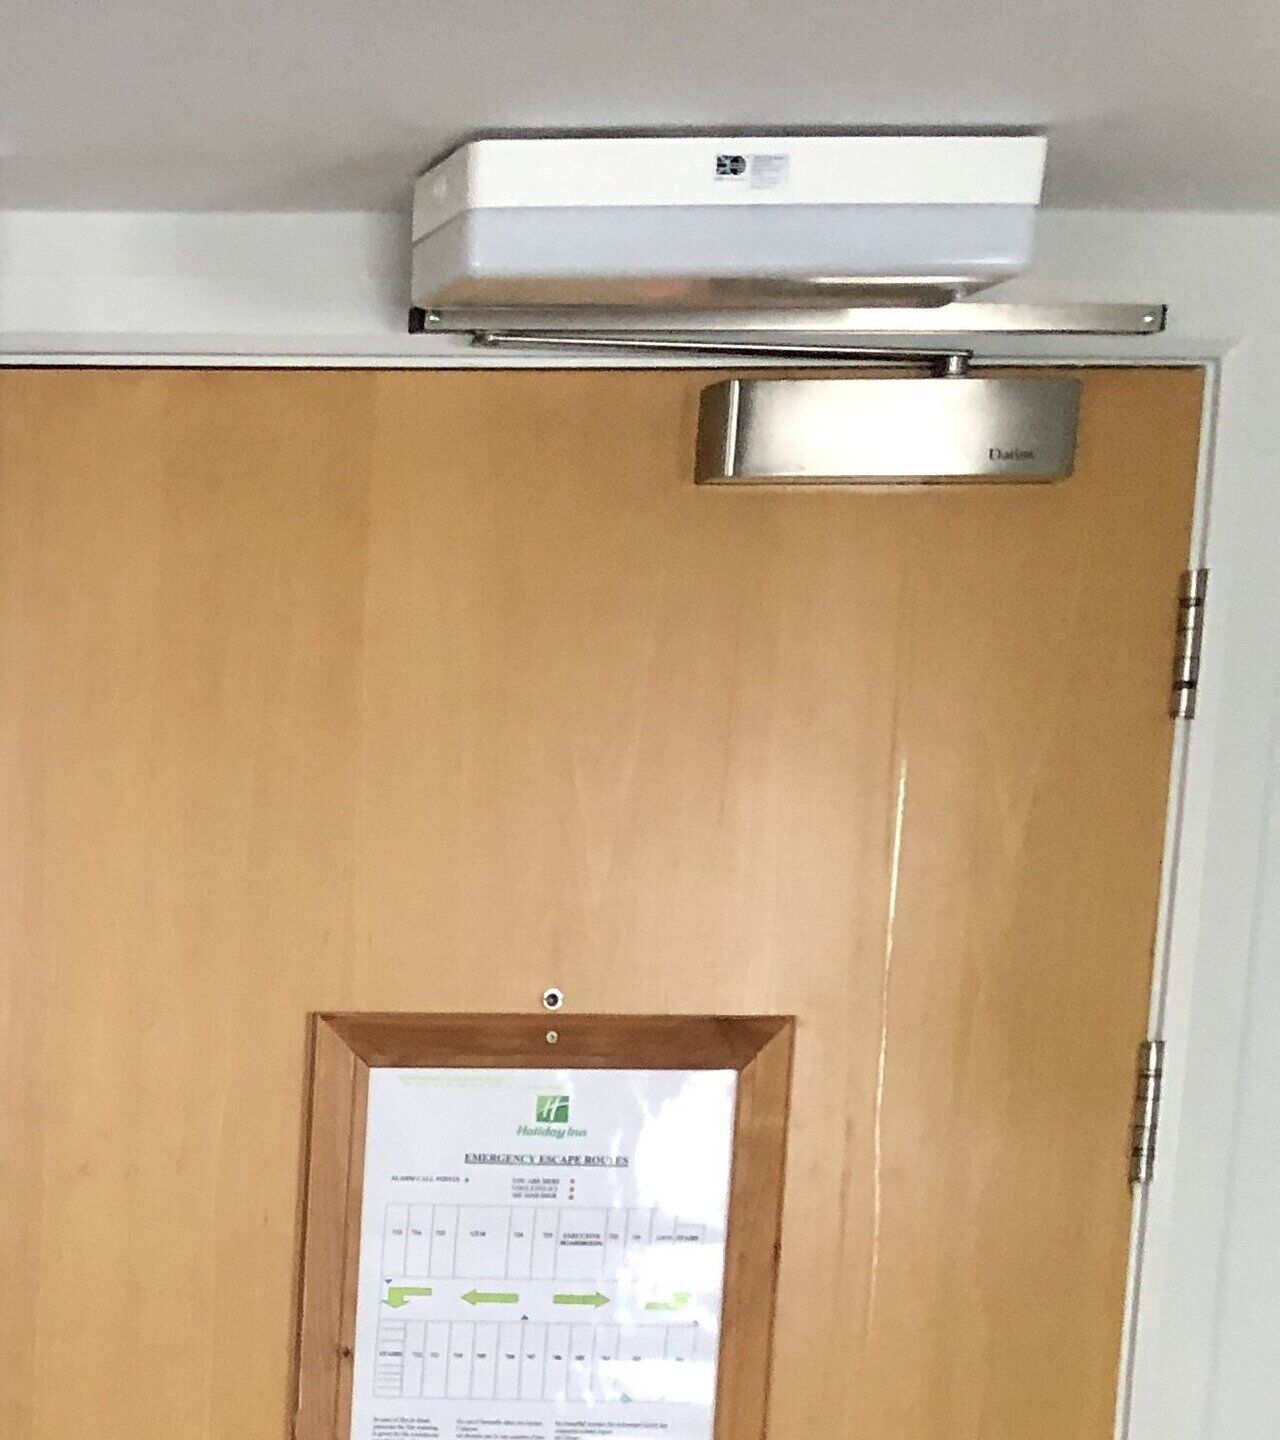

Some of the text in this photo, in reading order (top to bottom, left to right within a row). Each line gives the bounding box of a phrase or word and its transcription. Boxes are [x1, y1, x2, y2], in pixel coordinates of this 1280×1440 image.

[516, 1125, 587, 1139] Holiday Inn
[465, 1153, 535, 1165] EMERGENCY
[539, 1154, 580, 1166] ESCAPE
